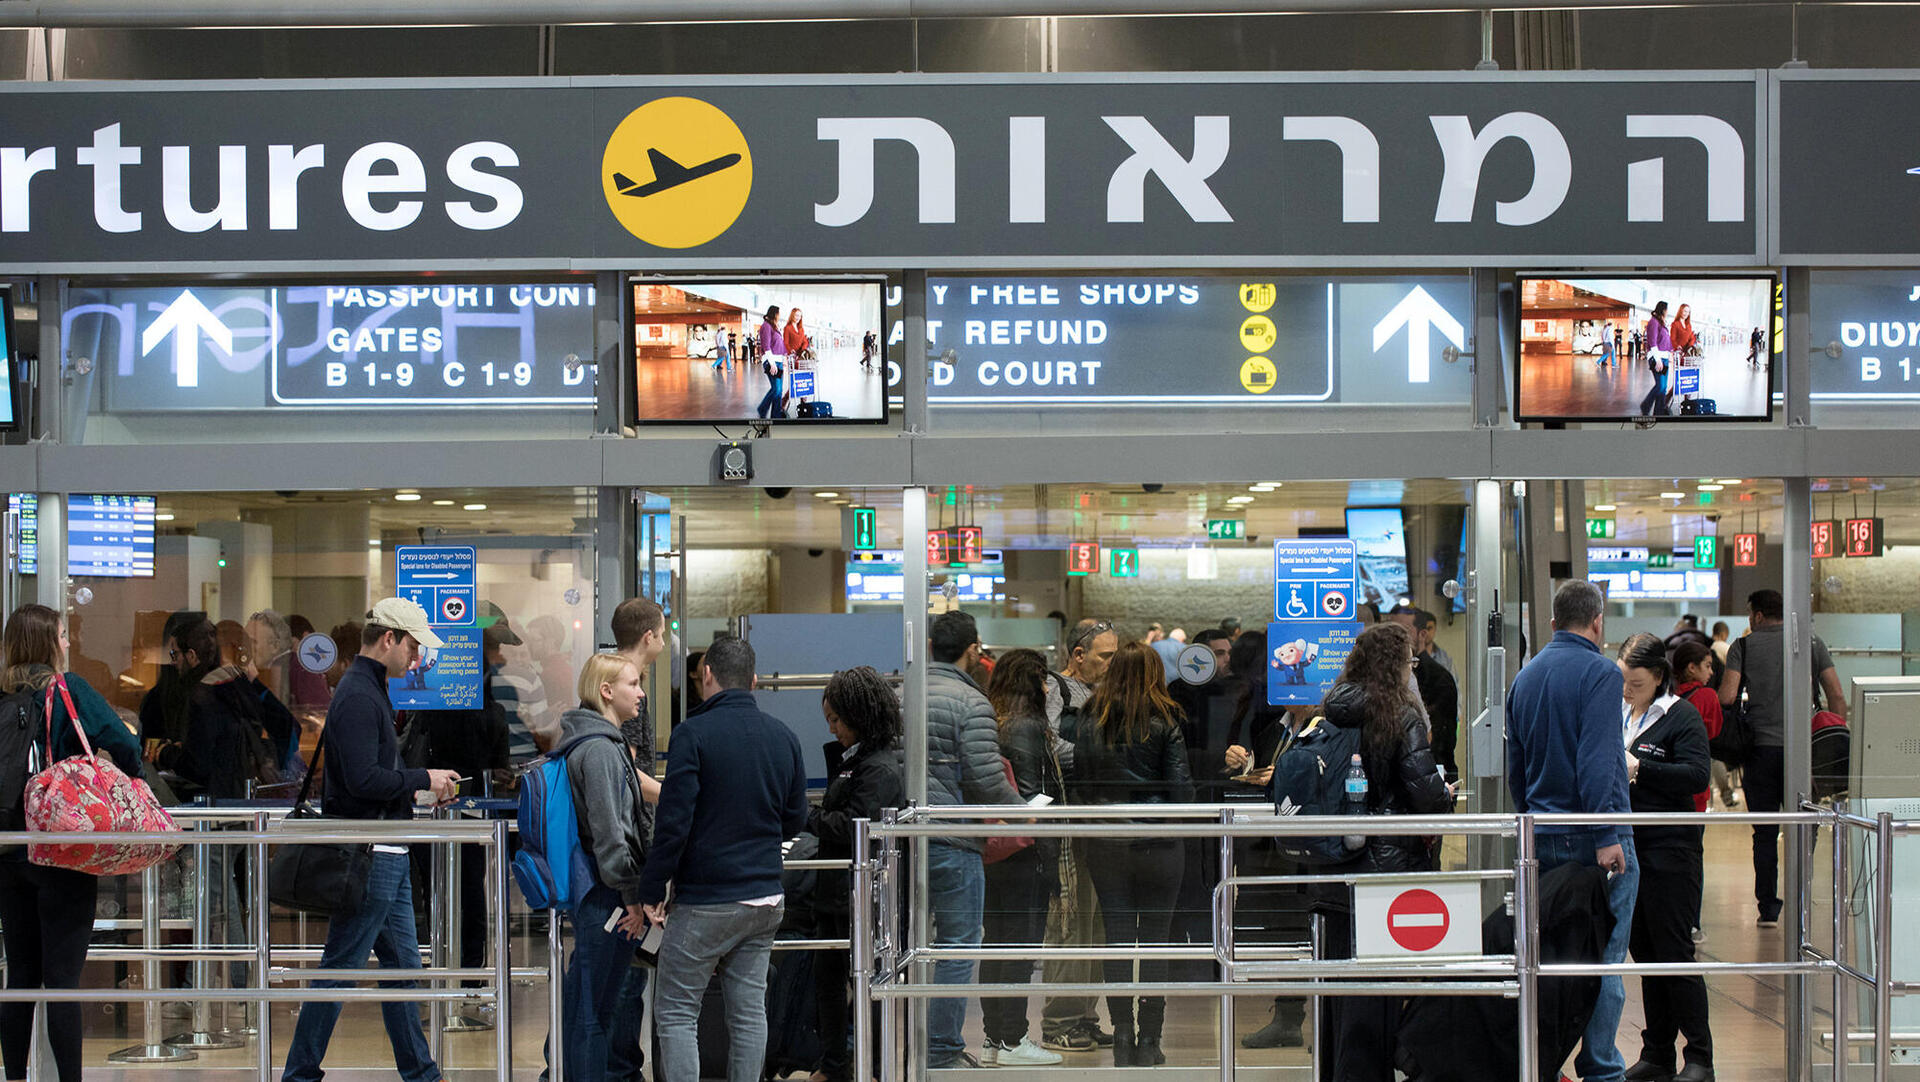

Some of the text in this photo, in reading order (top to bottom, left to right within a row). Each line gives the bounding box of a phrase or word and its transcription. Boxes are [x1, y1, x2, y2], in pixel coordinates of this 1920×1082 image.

[814, 111, 1745, 226] המראות
[326, 287, 494, 307] PASSPORT
[970, 285, 1060, 306] FREE
[1079, 284, 1199, 306] SHOPS
[326, 327, 443, 352] GATES
[965, 320, 1107, 345] REFUND
[326, 362, 348, 387] B
[363, 362, 414, 387] 1-9
[443, 361, 465, 387] C
[481, 362, 532, 387] 1-9
[977, 361, 1102, 387] COURT
[1861, 357, 1882, 382] B
[860, 512, 869, 532] 1
[1851, 521, 1870, 541] 16
[928, 533, 940, 550] 3
[964, 530, 975, 548] 2
[1811, 525, 1829, 544] 15
[1078, 545, 1090, 560] 5
[1699, 538, 1713, 555] 13
[1738, 537, 1753, 553] 14
[1119, 551, 1131, 565] 7
[437, 668, 464, 676] boarding
